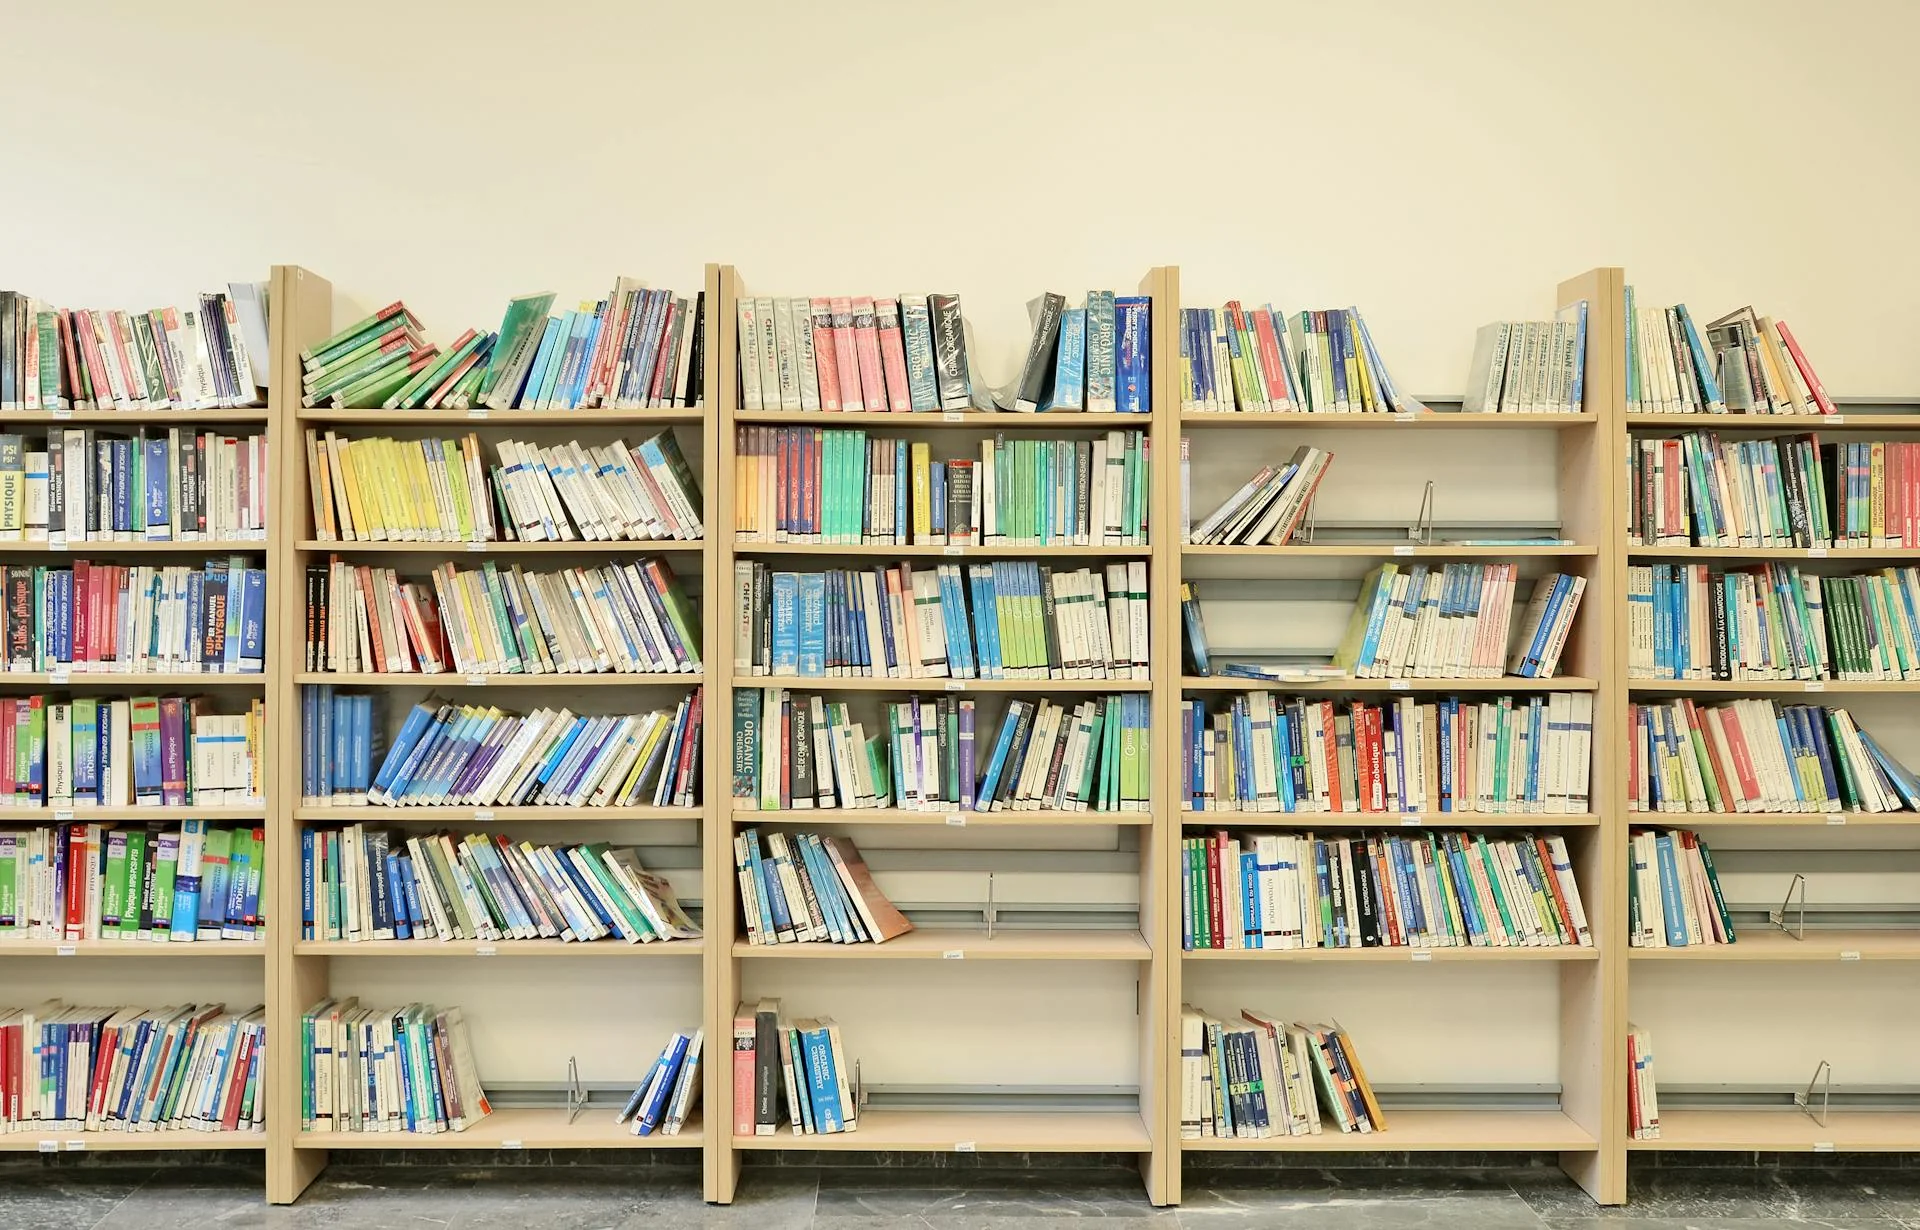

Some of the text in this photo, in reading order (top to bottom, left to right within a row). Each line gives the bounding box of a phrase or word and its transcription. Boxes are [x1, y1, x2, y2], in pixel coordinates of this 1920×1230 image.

[942, 310, 955, 352] ORGANIQUE
[1100, 322, 1112, 375] ORGANIC
[908, 328, 923, 379] ORGANIC
[1078, 454, 1086, 504] L'ENVIRONNEMENT
[4, 474, 16, 528] PHYSIQUE
[13, 581, 30, 617] physique
[13, 625, 27, 644] kilos
[205, 628, 216, 656] SUPER
[216, 595, 225, 650] PHYSIQUE
[168, 736, 177, 764] Physique
[744, 720, 753, 774] ORGANIC
[1371, 742, 1380, 785] Robotique
[126, 888, 137, 918] Physique
[236, 872, 245, 910] PHYSIQUE
[811, 1046, 824, 1090] CHEMISTRY
[818, 1044, 830, 1080] ORGANIC
